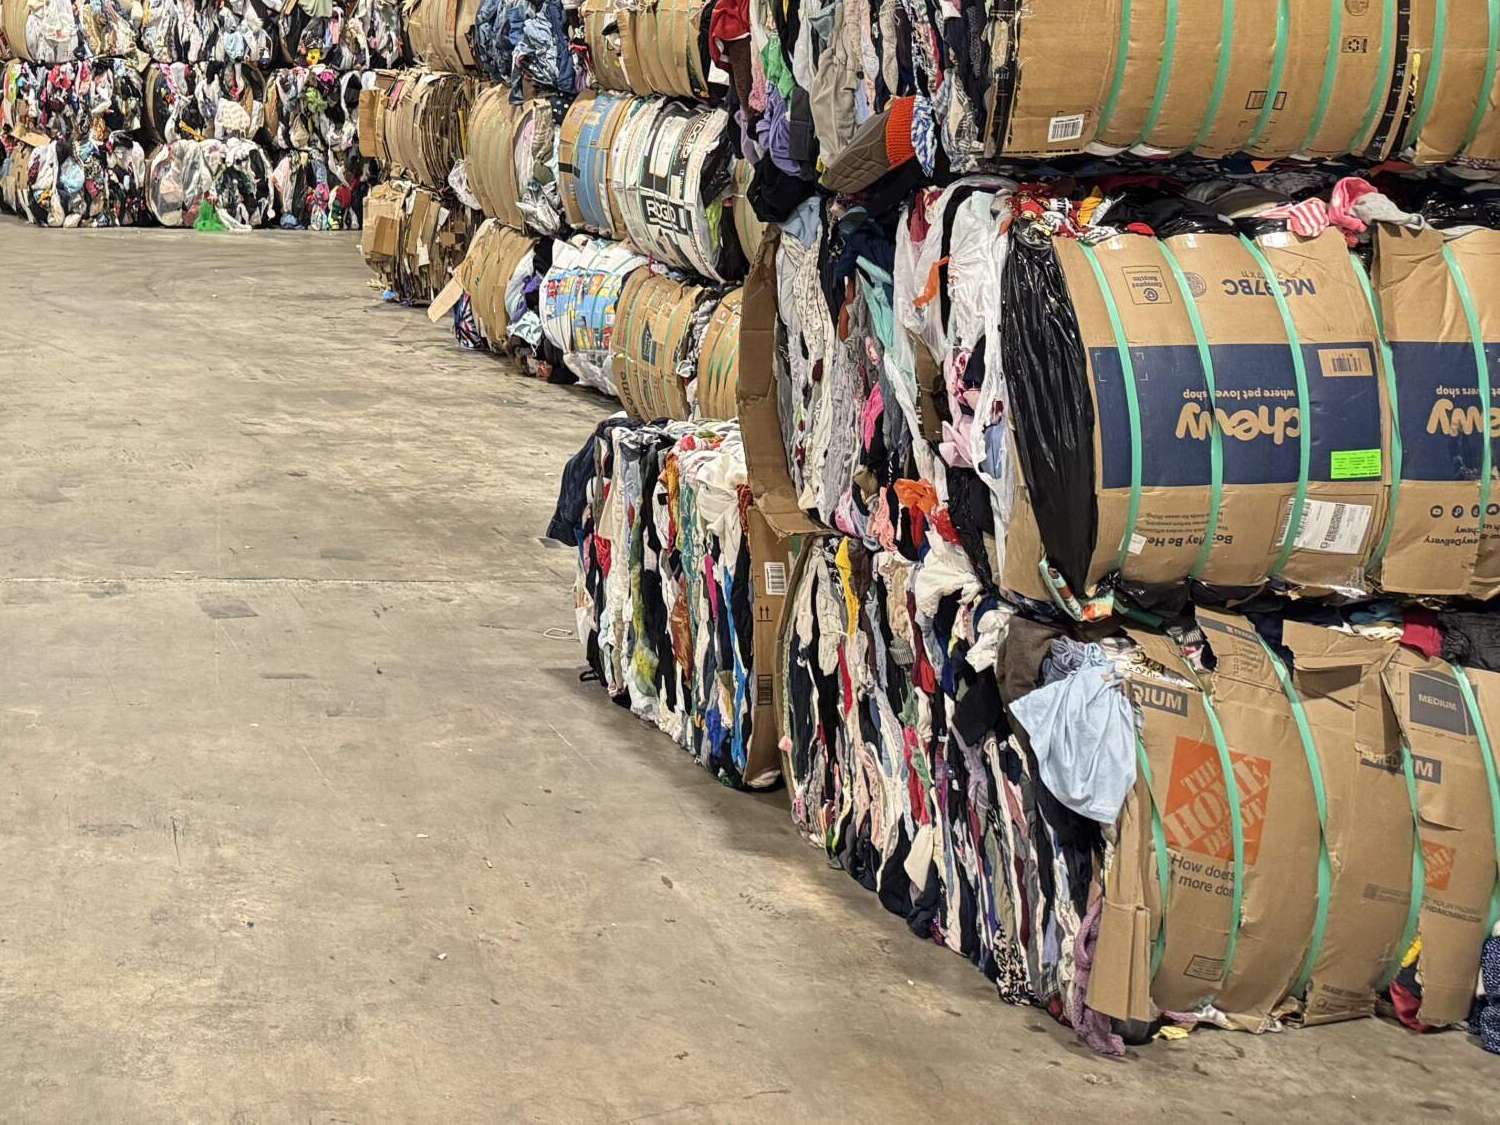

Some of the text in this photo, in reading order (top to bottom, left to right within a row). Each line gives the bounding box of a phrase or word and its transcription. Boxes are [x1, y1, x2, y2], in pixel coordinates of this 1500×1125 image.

[1182, 387, 1295, 400] shop love pet where
[1435, 385, 1460, 398] shop
[1176, 403, 1300, 444] chewy
[1427, 399, 1500, 439] ewy
[1168, 537, 1184, 547] Be
[1425, 535, 1478, 547] ewyDelivery
[1131, 683, 1183, 711] DIUM
[1418, 693, 1458, 712] MEDIUM
[1180, 757, 1221, 796] THE
[1171, 853, 1236, 883] How doers
[1178, 875, 1213, 893] more
[1215, 885, 1239, 900] don
